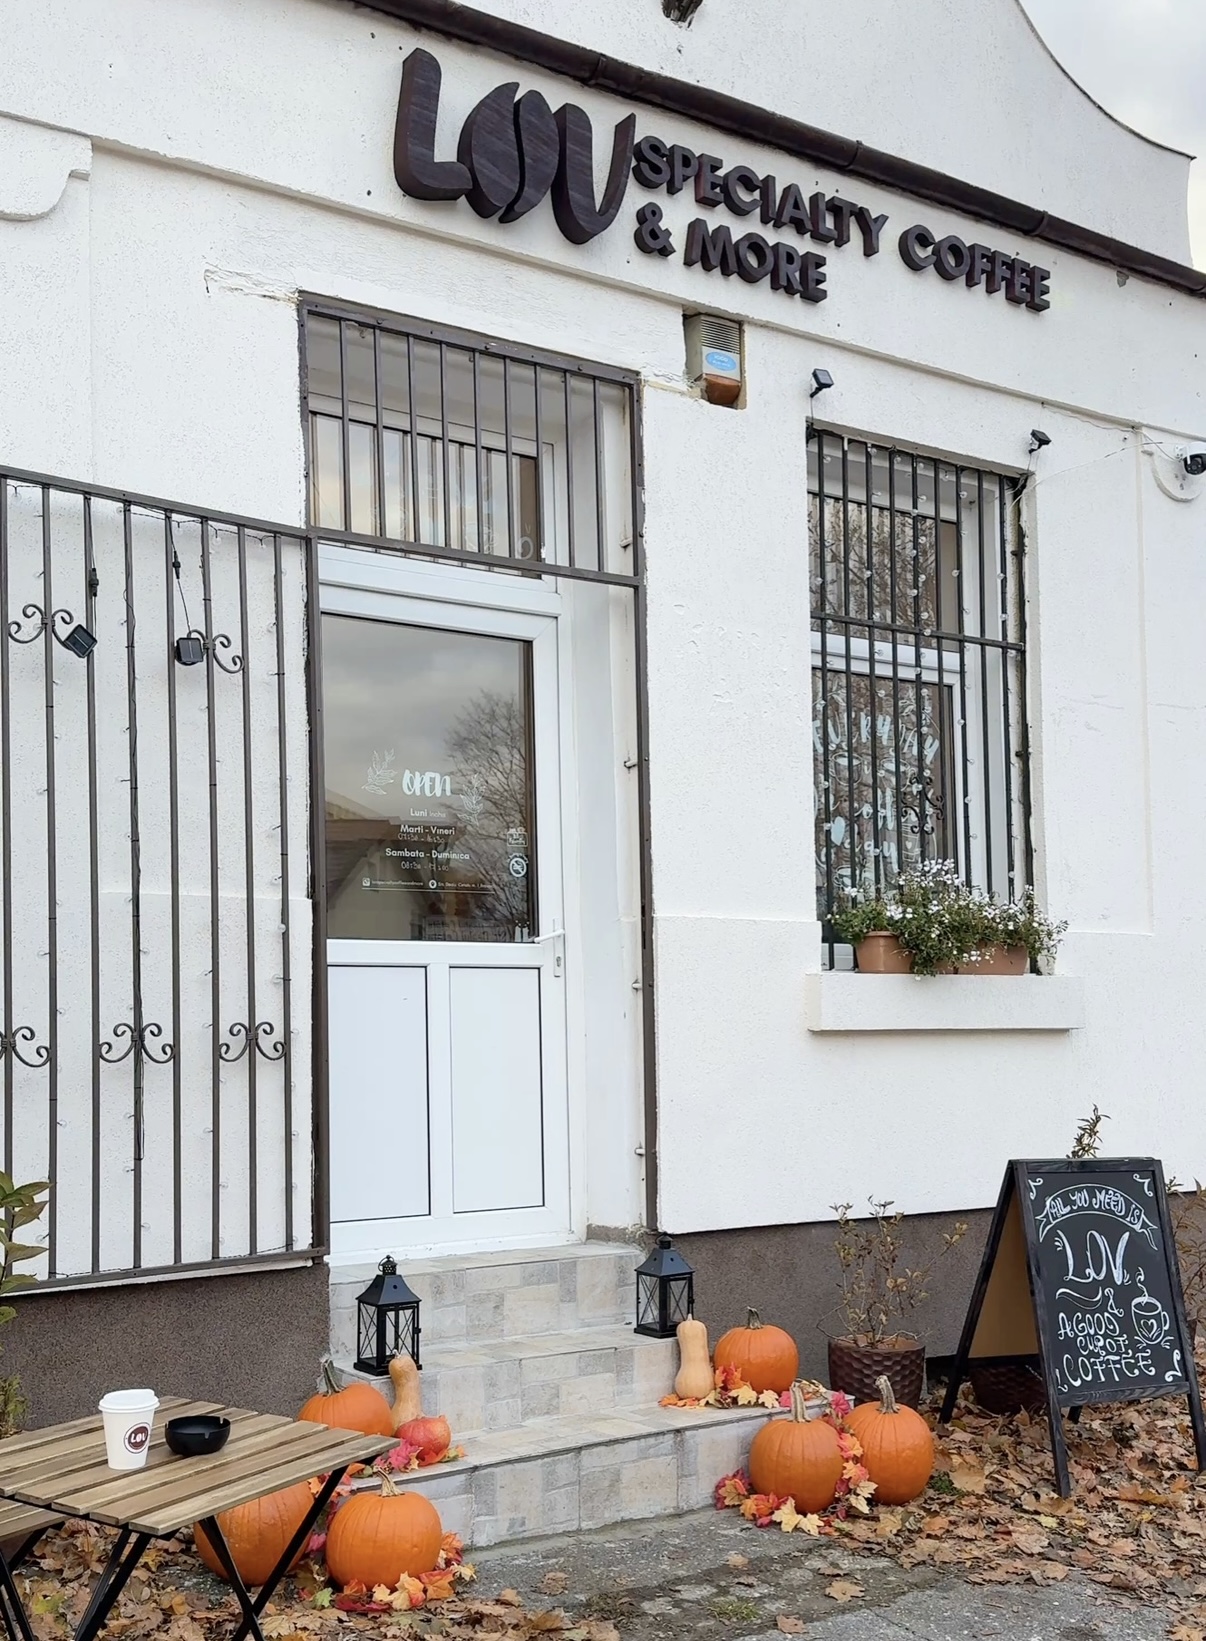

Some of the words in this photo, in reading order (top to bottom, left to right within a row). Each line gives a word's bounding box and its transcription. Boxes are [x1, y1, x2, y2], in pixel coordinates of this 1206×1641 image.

[393, 47, 636, 245] LOV
[632, 135, 889, 257] SPECIALTY
[898, 224, 1051, 313] COFFEE
[634, 202, 676, 257] &
[683, 218, 828, 303] MORE
[410, 808, 428, 817] Luni
[400, 824, 424, 834] Marti
[430, 826, 455, 835] Vineri
[385, 848, 425, 858] Sambata
[431, 850, 470, 860] Duminica
[1049, 1197, 1071, 1218] ALL
[1069, 1188, 1090, 1210] YOU
[1092, 1188, 1126, 1216] NEED
[1057, 1230, 1130, 1285] LOV
[1104, 1287, 1125, 1318] &
[1057, 1312, 1075, 1340] A
[1072, 1311, 1120, 1337] GOOD
[1076, 1335, 1105, 1356] CUP
[1105, 1333, 1129, 1353] OF
[1063, 1349, 1156, 1387] COFFEE
